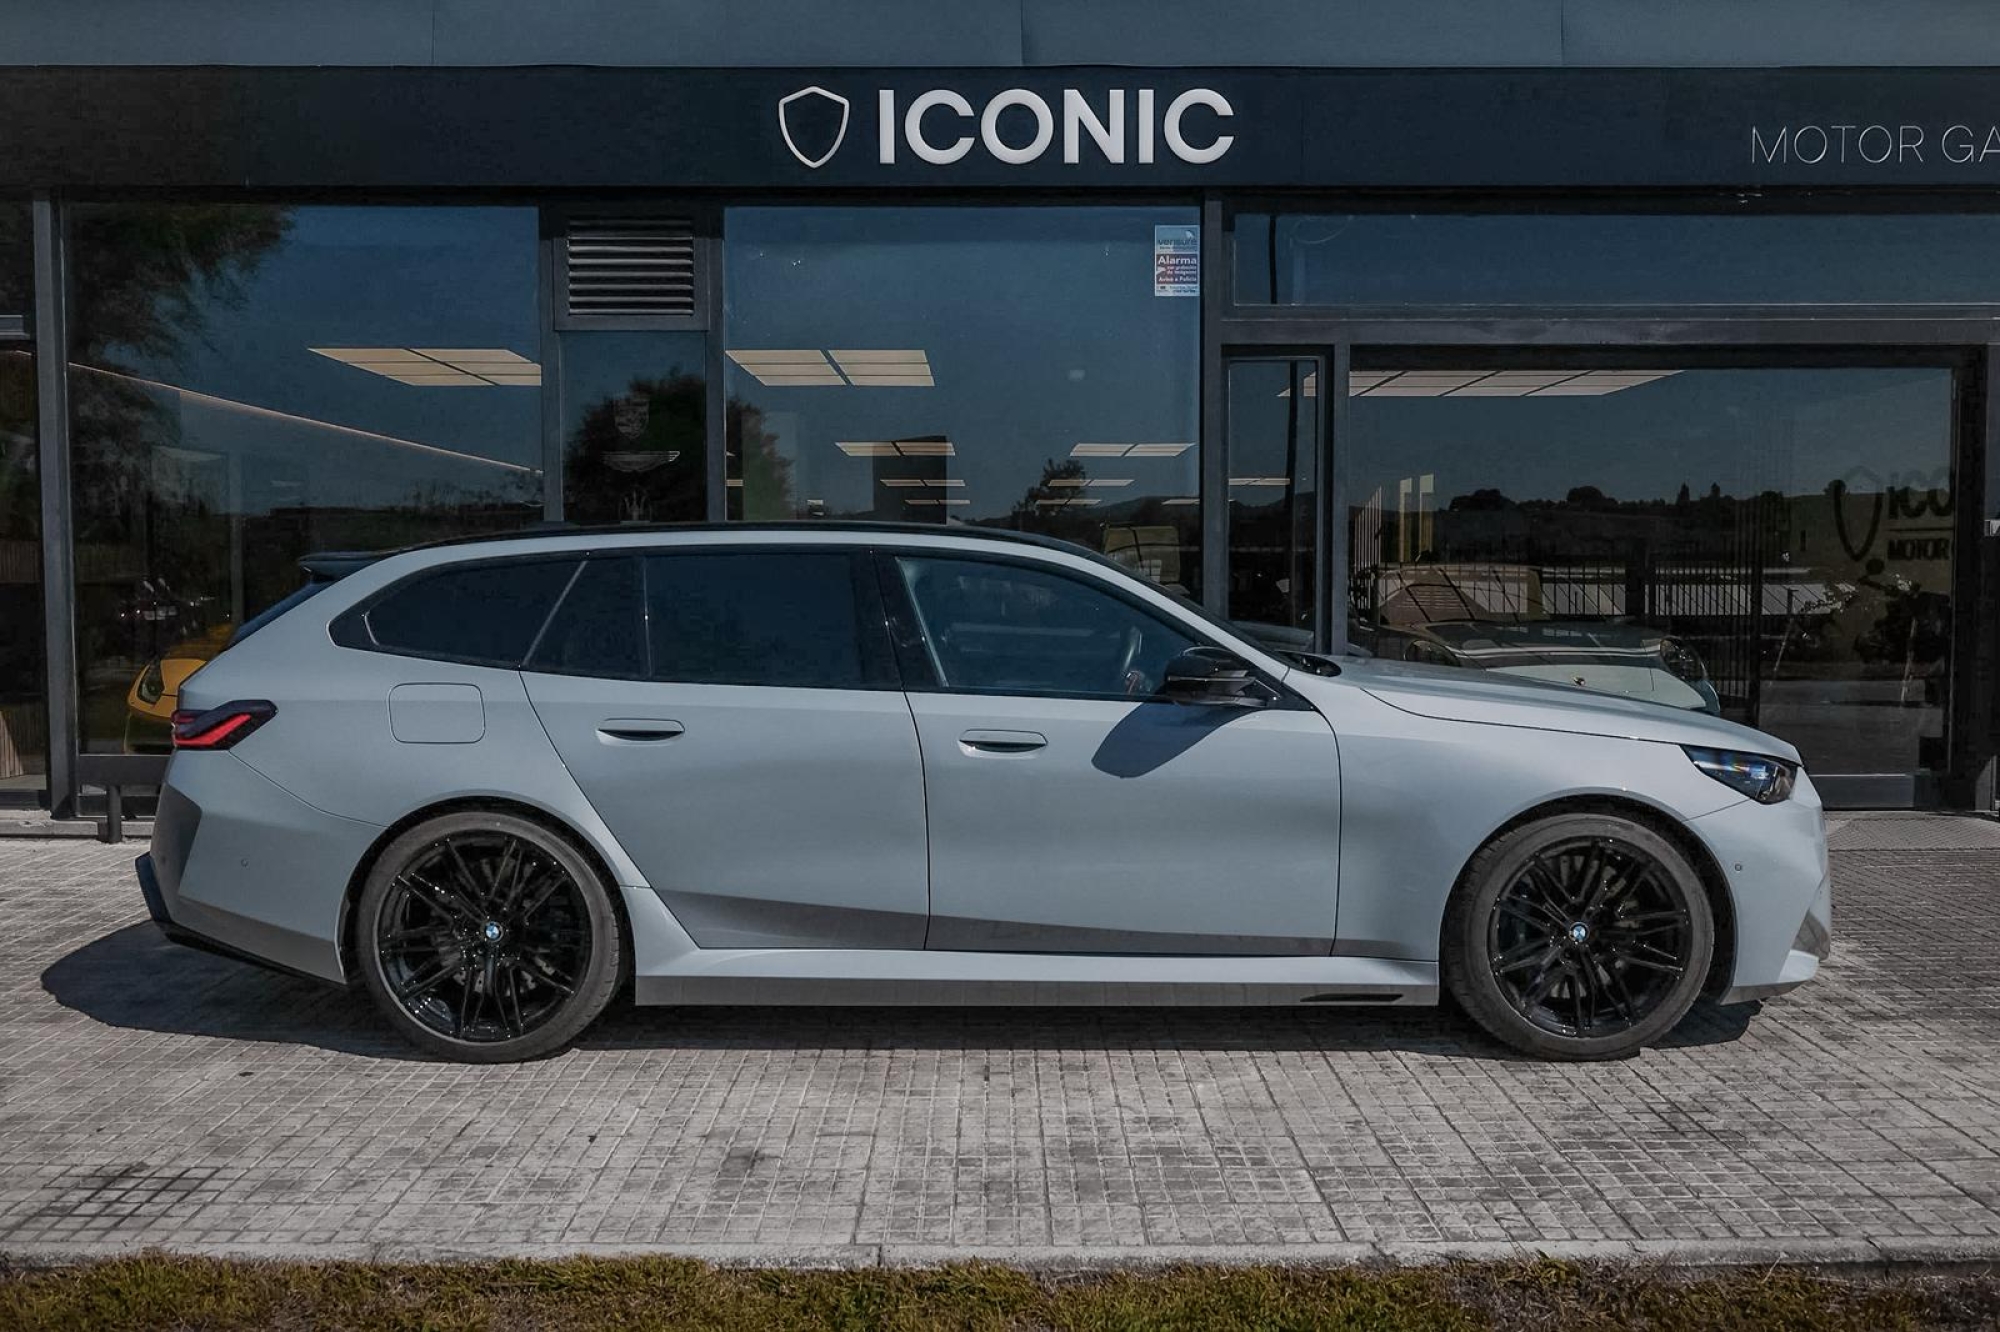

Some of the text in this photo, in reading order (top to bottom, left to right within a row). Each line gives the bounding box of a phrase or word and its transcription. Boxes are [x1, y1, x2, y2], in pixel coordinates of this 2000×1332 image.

[879, 88, 1235, 165] ICONIC
[1751, 124, 1925, 164] MOTOR
[1158, 255, 1197, 265] Alarma
[1887, 539, 1950, 561] MOTOR
